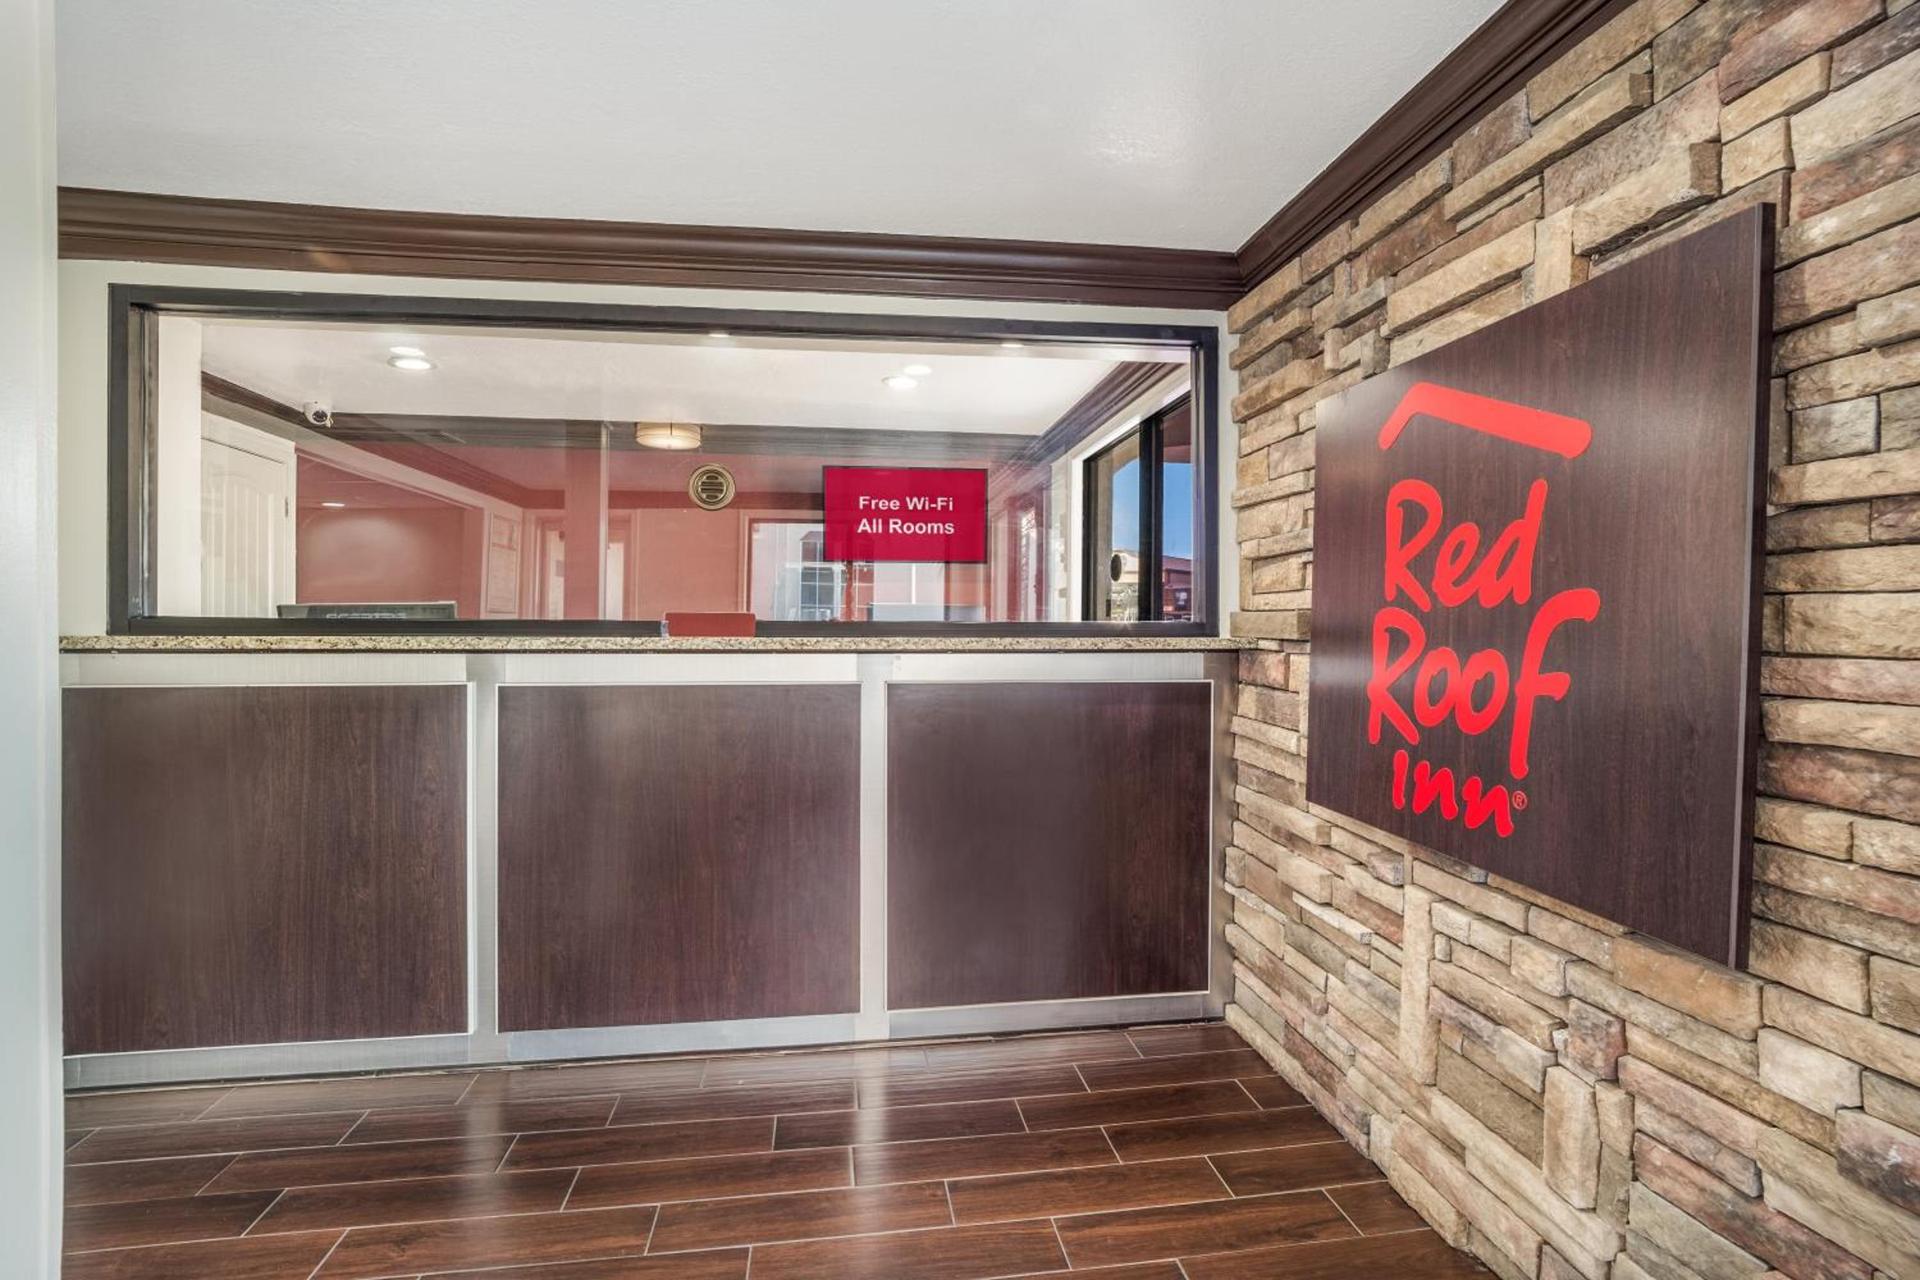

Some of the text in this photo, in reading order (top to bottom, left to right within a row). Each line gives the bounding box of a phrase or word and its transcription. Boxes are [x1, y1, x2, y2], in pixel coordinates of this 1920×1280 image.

[857, 518, 955, 535] All Rooms
[858, 495, 954, 511] Free Wi-Fi
[1384, 478, 1549, 613] Red
[1366, 587, 1601, 780] Roof
